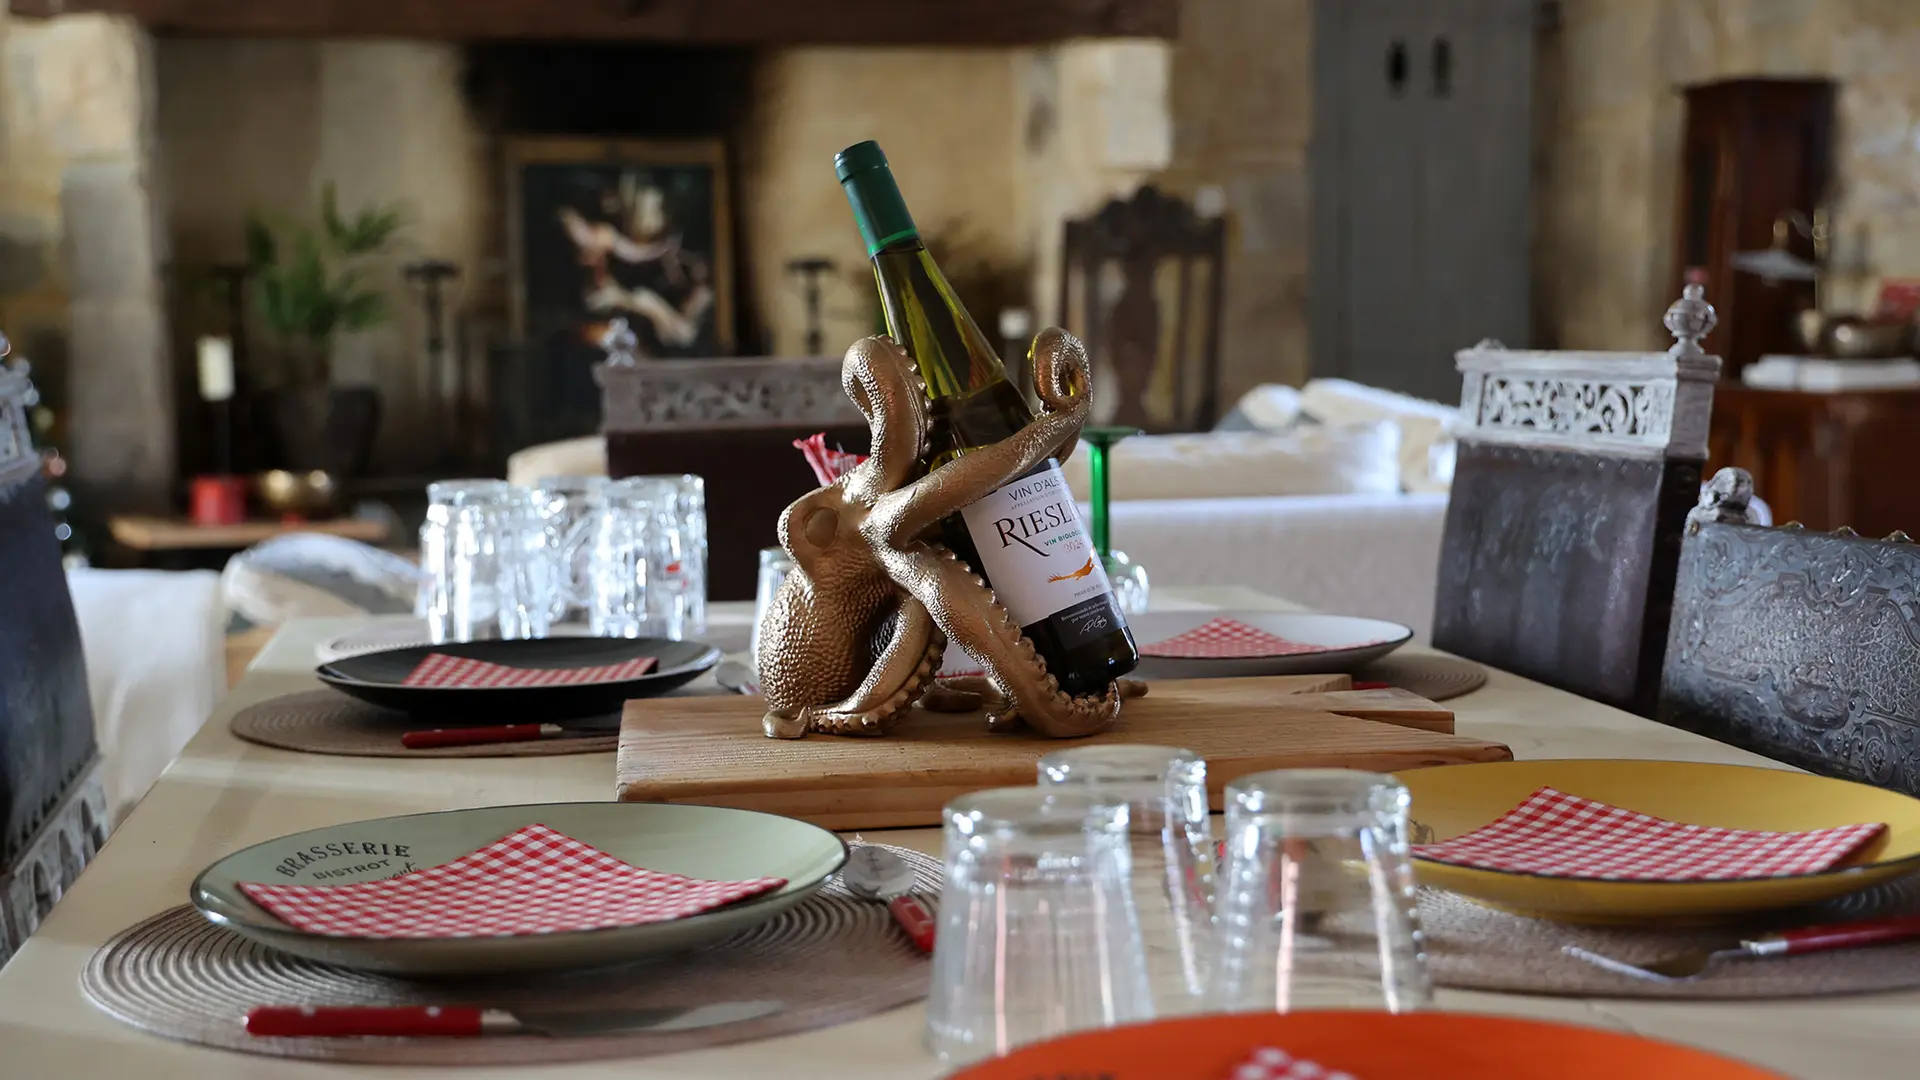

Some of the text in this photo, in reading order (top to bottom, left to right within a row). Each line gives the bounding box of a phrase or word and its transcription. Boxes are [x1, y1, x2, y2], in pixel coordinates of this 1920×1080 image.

[1008, 485, 1032, 501] VIN
[1033, 476, 1060, 493] D'ALS
[1044, 529, 1083, 547] VIN BIOLOG
[275, 841, 411, 878] BRASSERIE
[312, 858, 391, 880] BISTROT
